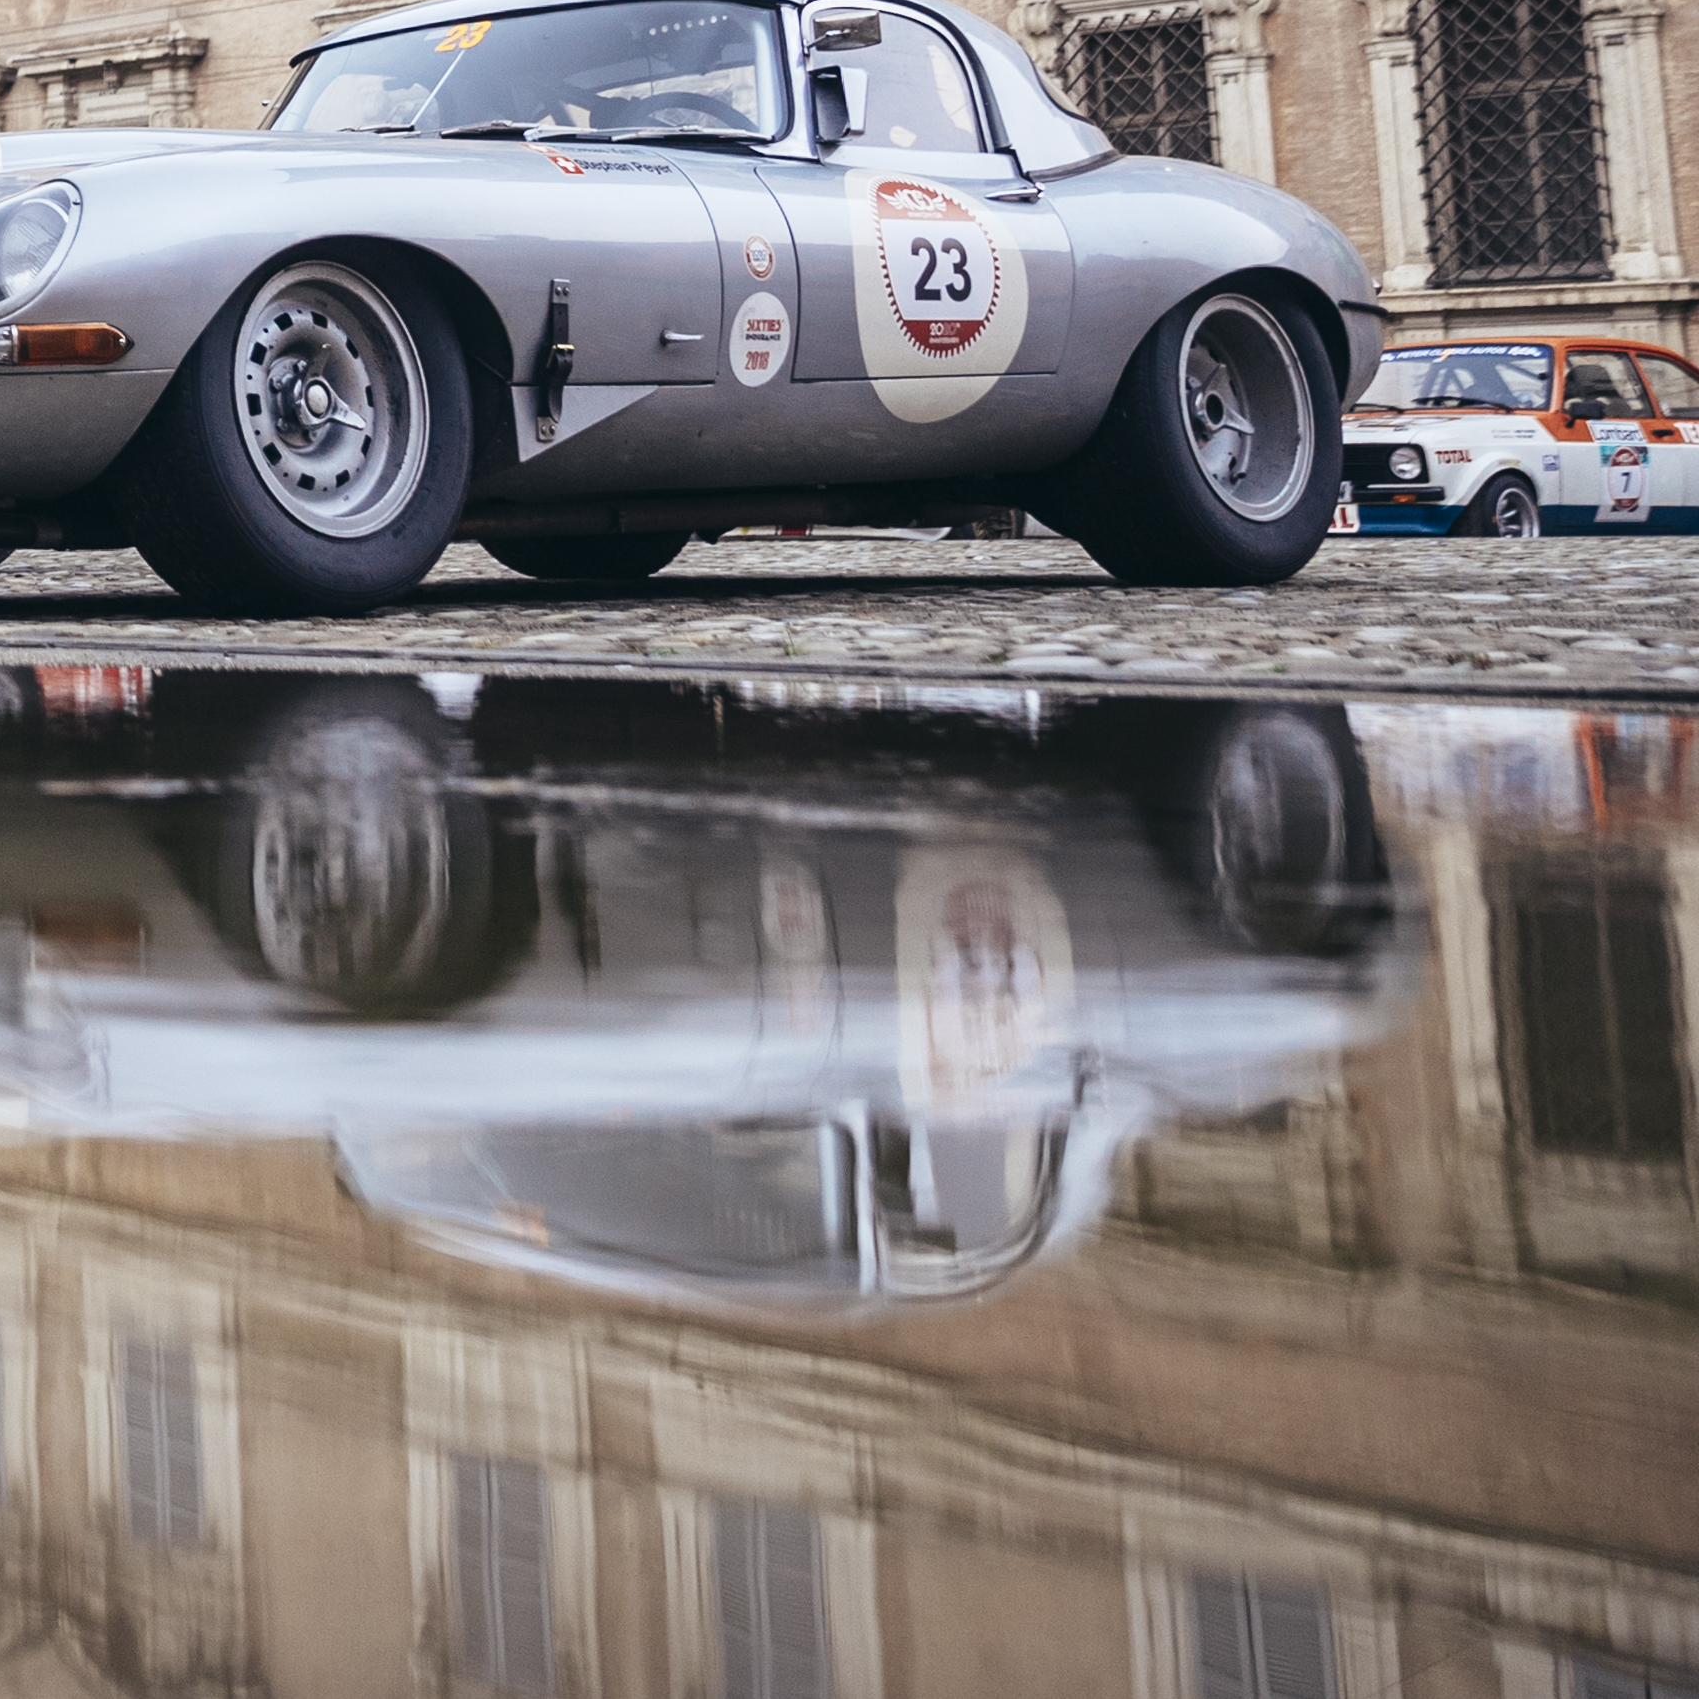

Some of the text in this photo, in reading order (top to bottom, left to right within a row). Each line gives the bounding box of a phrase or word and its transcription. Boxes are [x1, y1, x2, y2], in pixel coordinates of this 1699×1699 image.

[434, 20, 492, 53] 23
[573, 159, 673, 176] Stephan Peyer
[911, 237, 972, 302] 23
[746, 319, 782, 332] SIXTIES
[744, 351, 770, 370] 2018
[1435, 449, 1473, 465] TOTAL
[1621, 471, 1631, 493] 7
